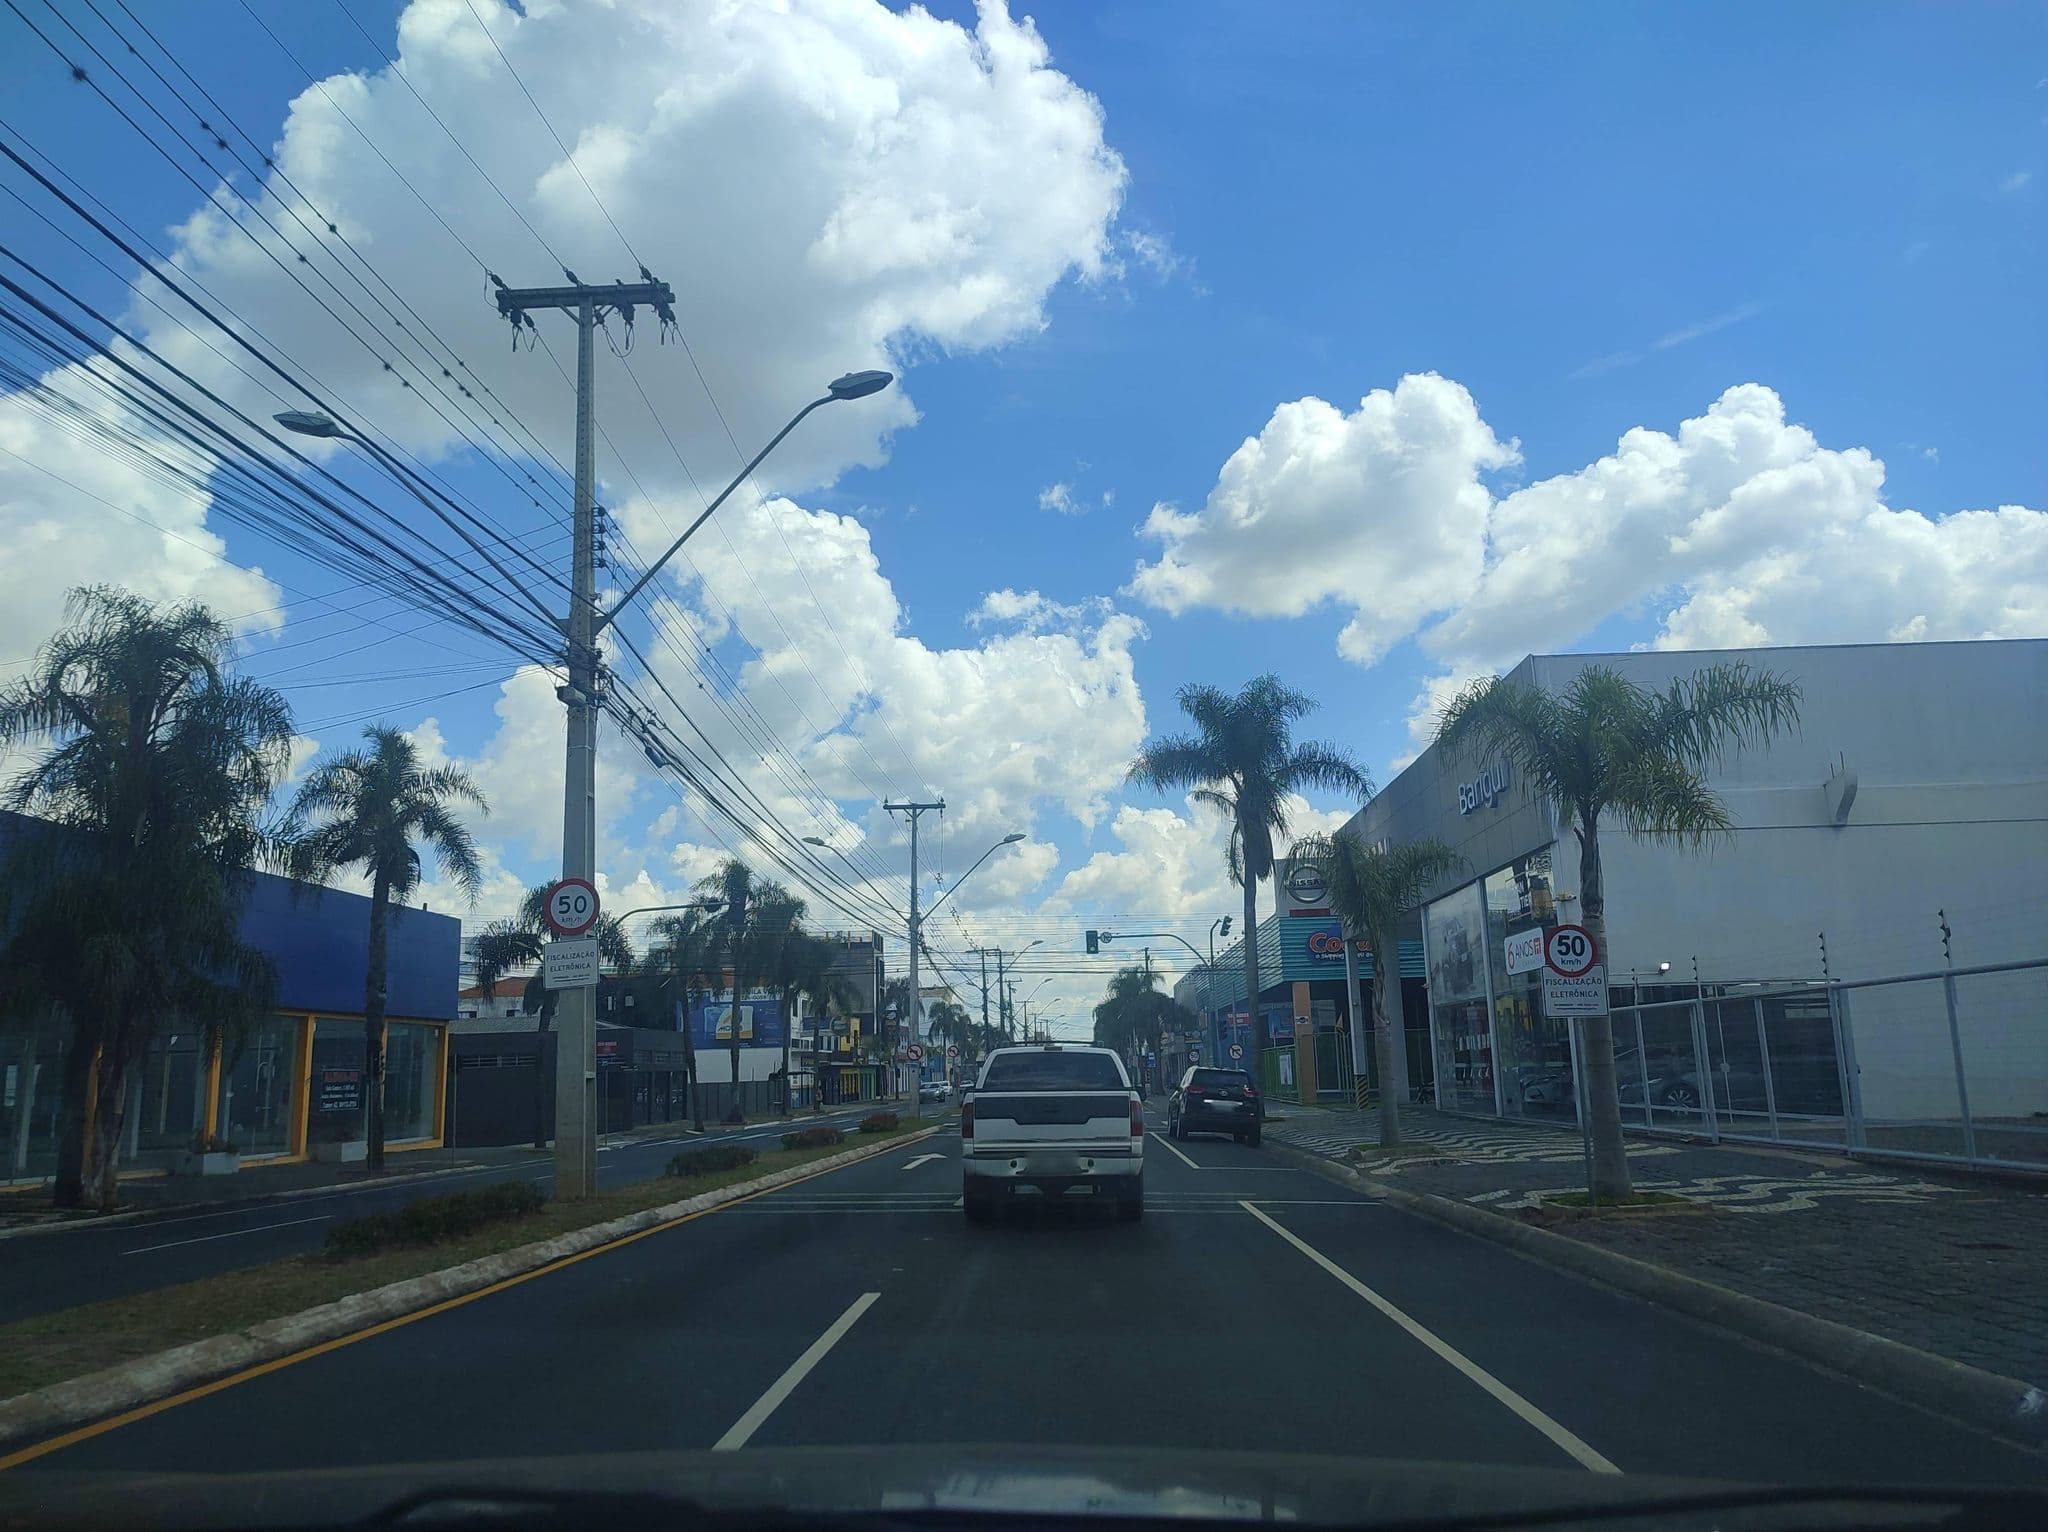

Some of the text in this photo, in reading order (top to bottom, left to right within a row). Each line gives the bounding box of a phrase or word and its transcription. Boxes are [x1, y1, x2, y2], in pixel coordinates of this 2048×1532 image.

[558, 895, 588, 915] 50
[1556, 935, 1586, 957] 50
[546, 951, 595, 962] FISCALIZAÇÃO
[1507, 941, 1515, 970] 6
[1515, 939, 1534, 959] ANOS
[549, 962, 591, 973] ELETRÔNICA
[1560, 958, 1582, 966] km/h
[1545, 976, 1602, 987] FISCALIZAÇÃO
[1551, 989, 1599, 999] ELETRÔNICA
